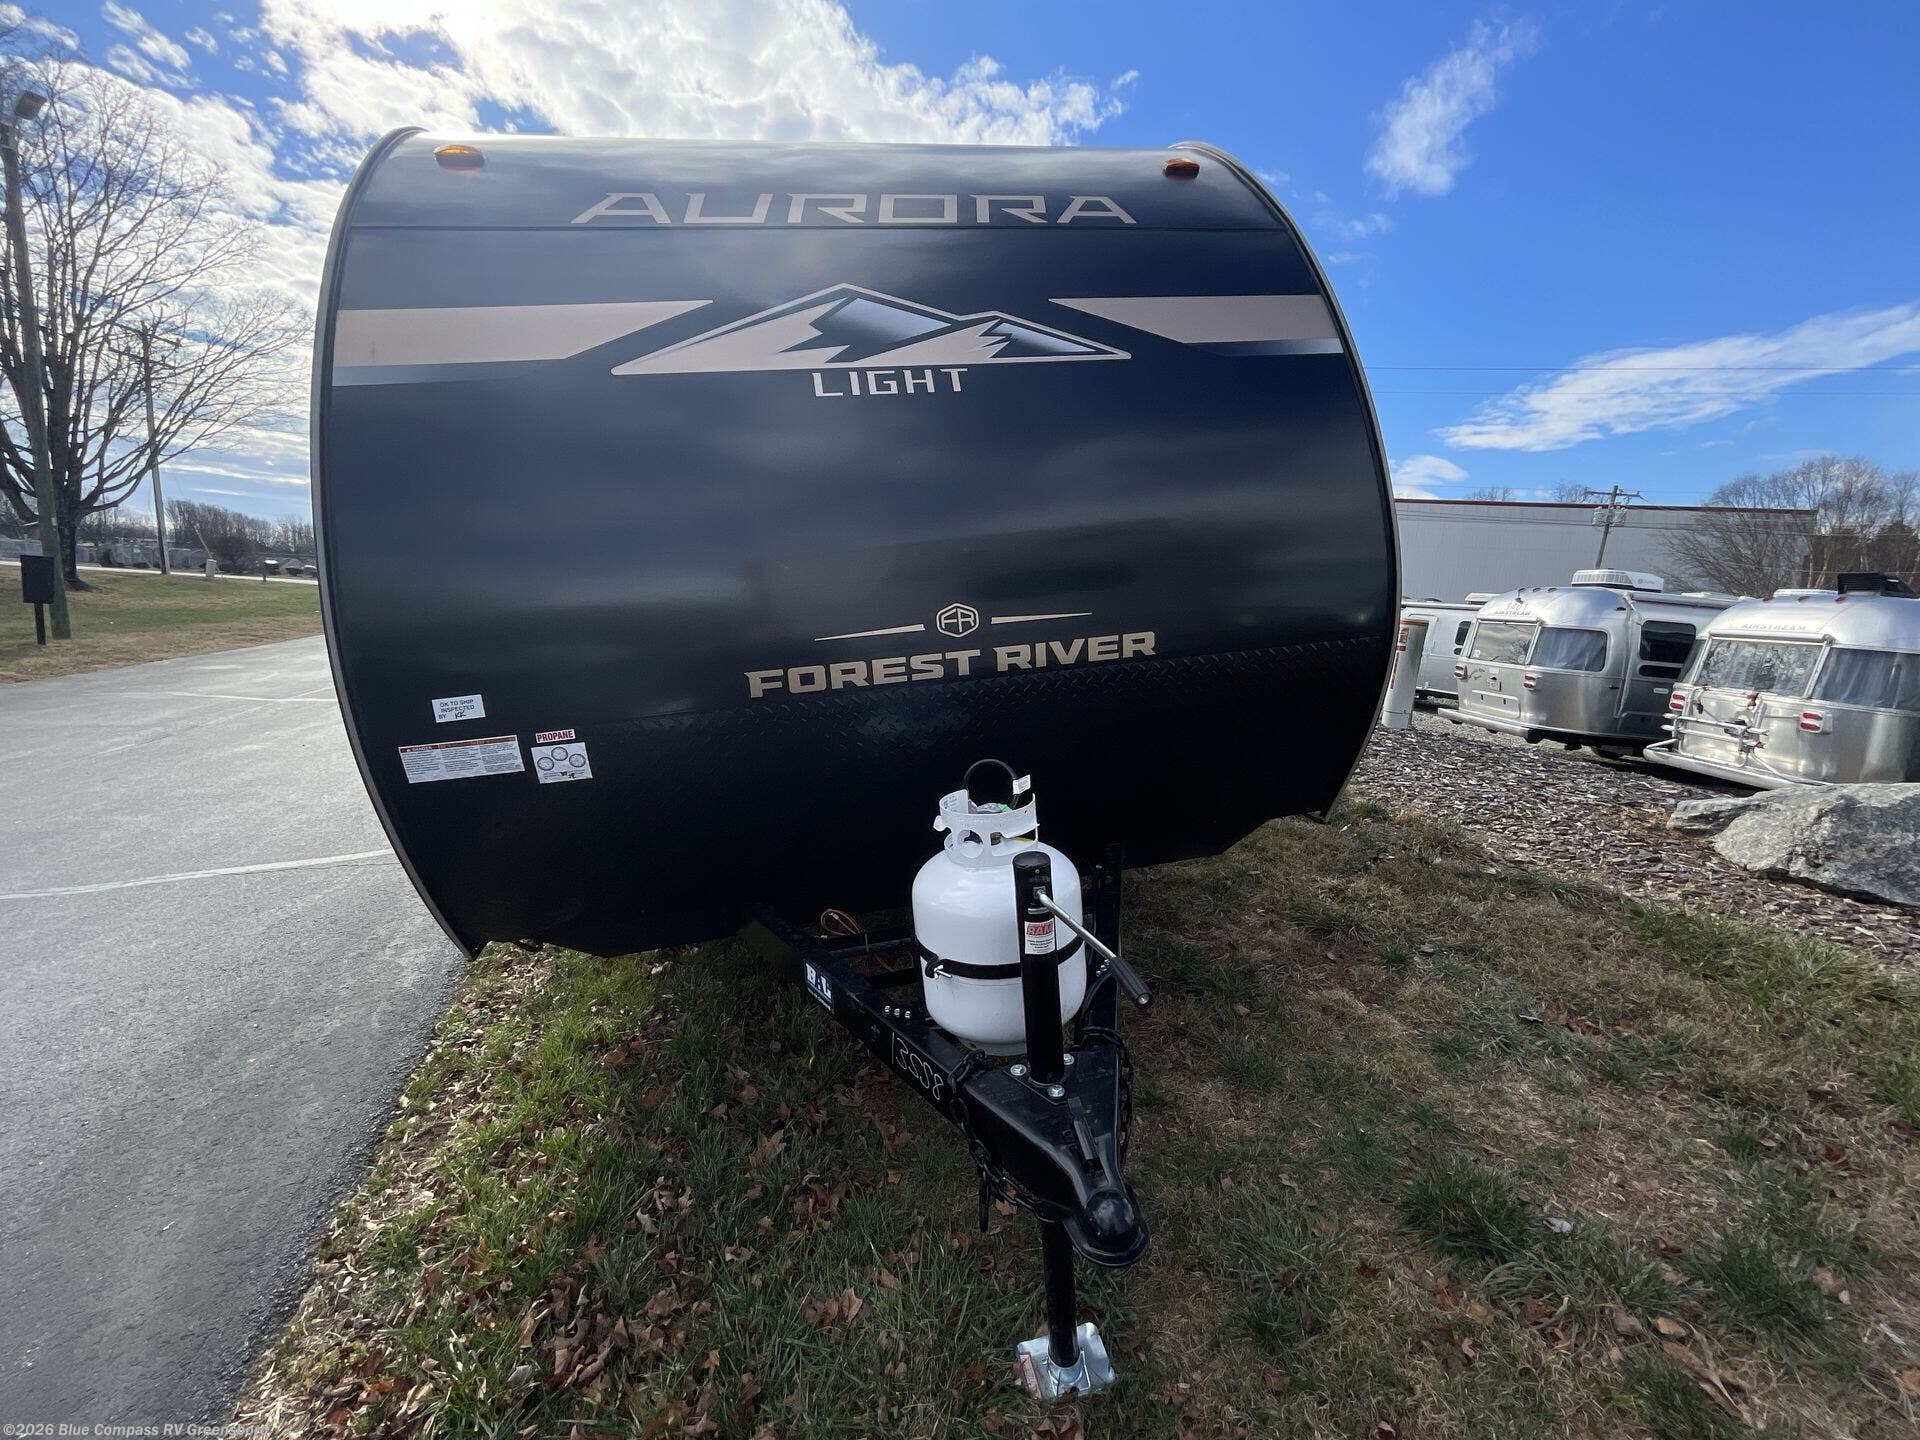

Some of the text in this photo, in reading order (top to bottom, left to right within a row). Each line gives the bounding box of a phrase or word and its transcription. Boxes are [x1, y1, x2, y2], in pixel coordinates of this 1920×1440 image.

[570, 192, 1137, 225] AURORA
[811, 367, 969, 398] LIGHT
[1741, 623, 1807, 631] AIRSTREAM
[743, 631, 1157, 699] FOREST RIVER
[440, 704, 475, 713] INSPECTED
[536, 730, 574, 742] PROPANE
[1027, 922, 1054, 936] RAM
